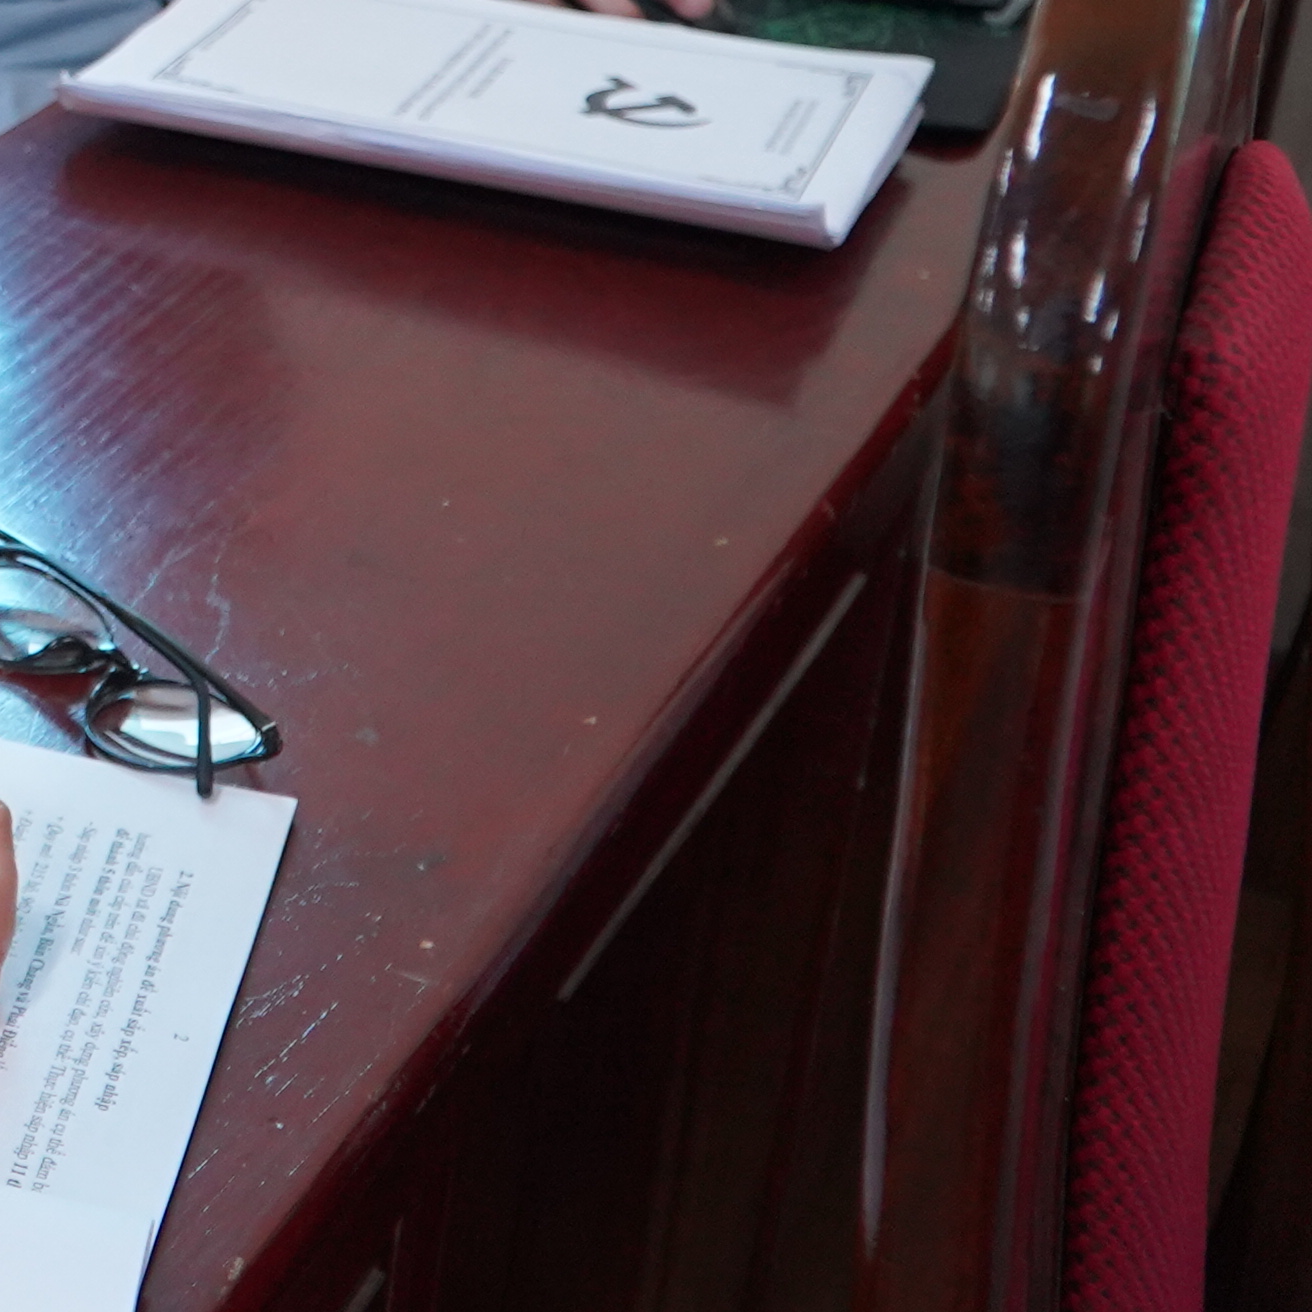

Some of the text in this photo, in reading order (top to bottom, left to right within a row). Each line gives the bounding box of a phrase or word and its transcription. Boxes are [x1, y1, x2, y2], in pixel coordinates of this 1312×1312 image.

[144, 923, 173, 964] phương
[16, 957, 46, 991] Chang
[143, 963, 158, 978] án
[138, 978, 157, 993] đề
[130, 992, 151, 1018] xuất
[119, 1017, 142, 1038] sắp
[172, 1032, 190, 1043] 2
[111, 1037, 138, 1061] xếp,
[104, 1061, 126, 1082] sáp
[93, 1082, 119, 1112] nhập
[10, 1064, 68, 1177] Thực hiện sáp nhập 11
[35, 1066, 89, 1180] phương án cụ thể đảm
